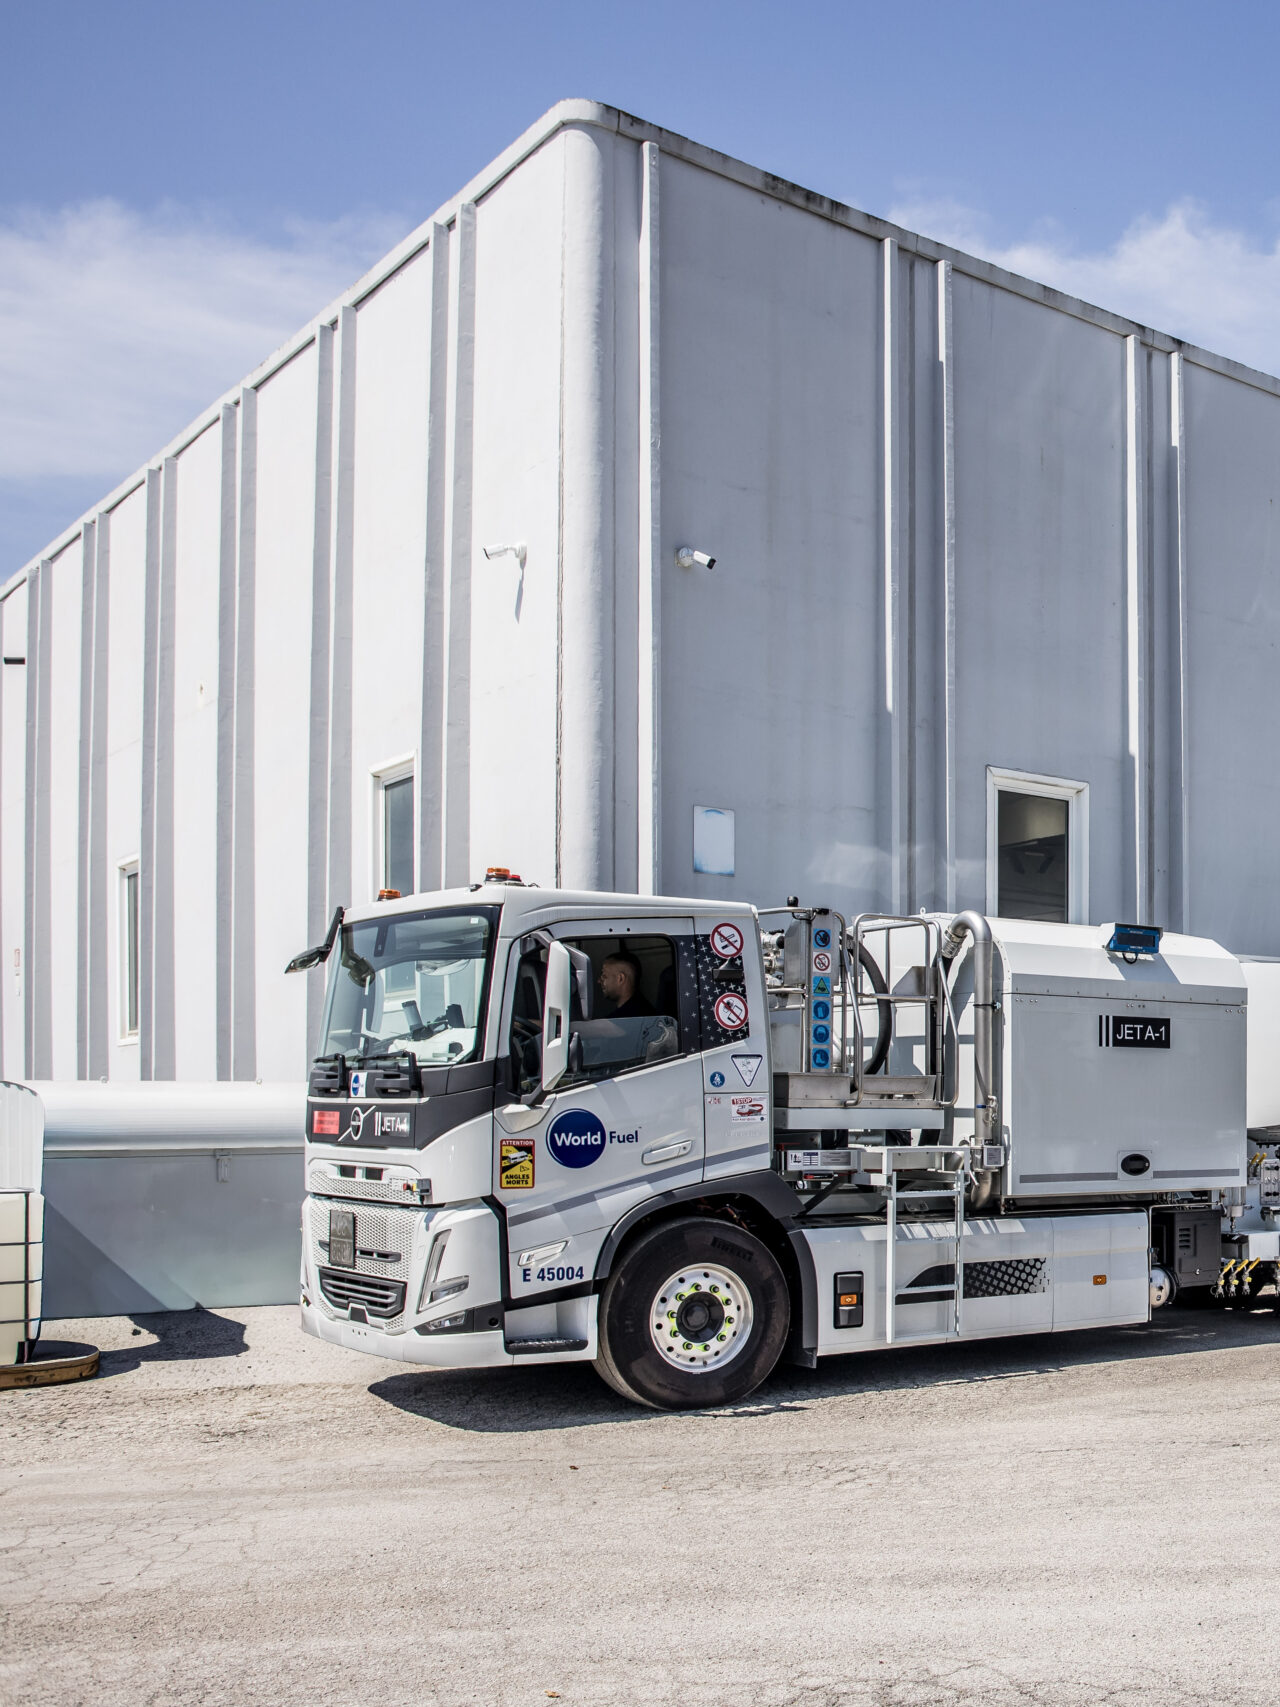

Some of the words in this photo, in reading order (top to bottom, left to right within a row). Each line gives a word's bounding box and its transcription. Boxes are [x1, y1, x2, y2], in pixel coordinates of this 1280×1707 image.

[1116, 1024, 1143, 1040] JET
[1144, 1025, 1166, 1041] A-1
[554, 1131, 602, 1147] World
[609, 1130, 639, 1144] Fuel
[522, 1268, 531, 1282] E
[536, 1265, 585, 1281] 45004
